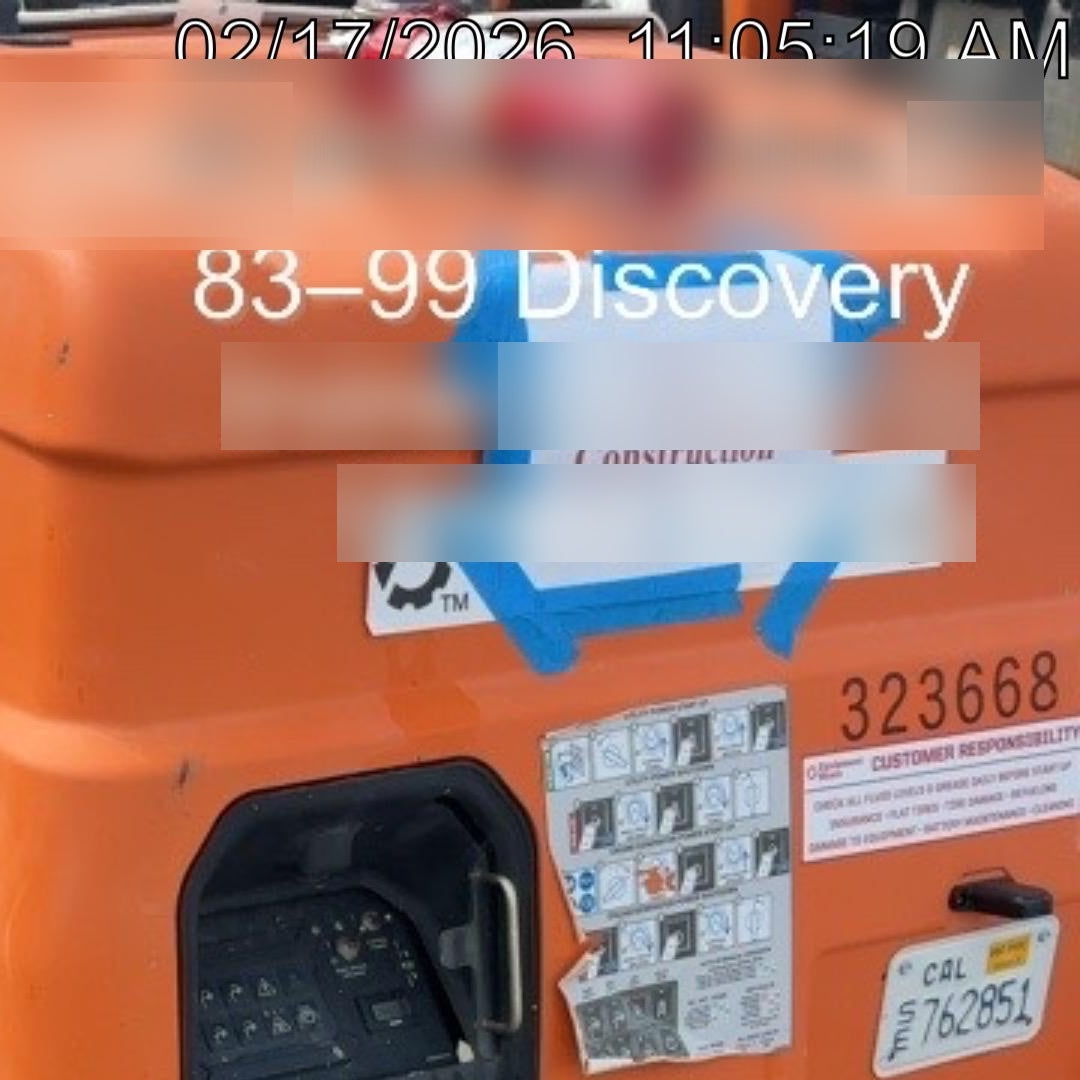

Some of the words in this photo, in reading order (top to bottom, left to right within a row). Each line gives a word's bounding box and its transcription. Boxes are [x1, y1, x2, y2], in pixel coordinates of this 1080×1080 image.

[441, 592, 469, 613] TM
[840, 650, 1060, 742] 323668
[871, 744, 955, 772] CUSTOMER
[923, 957, 967, 987] CAL
[923, 977, 1033, 1044] 762851
